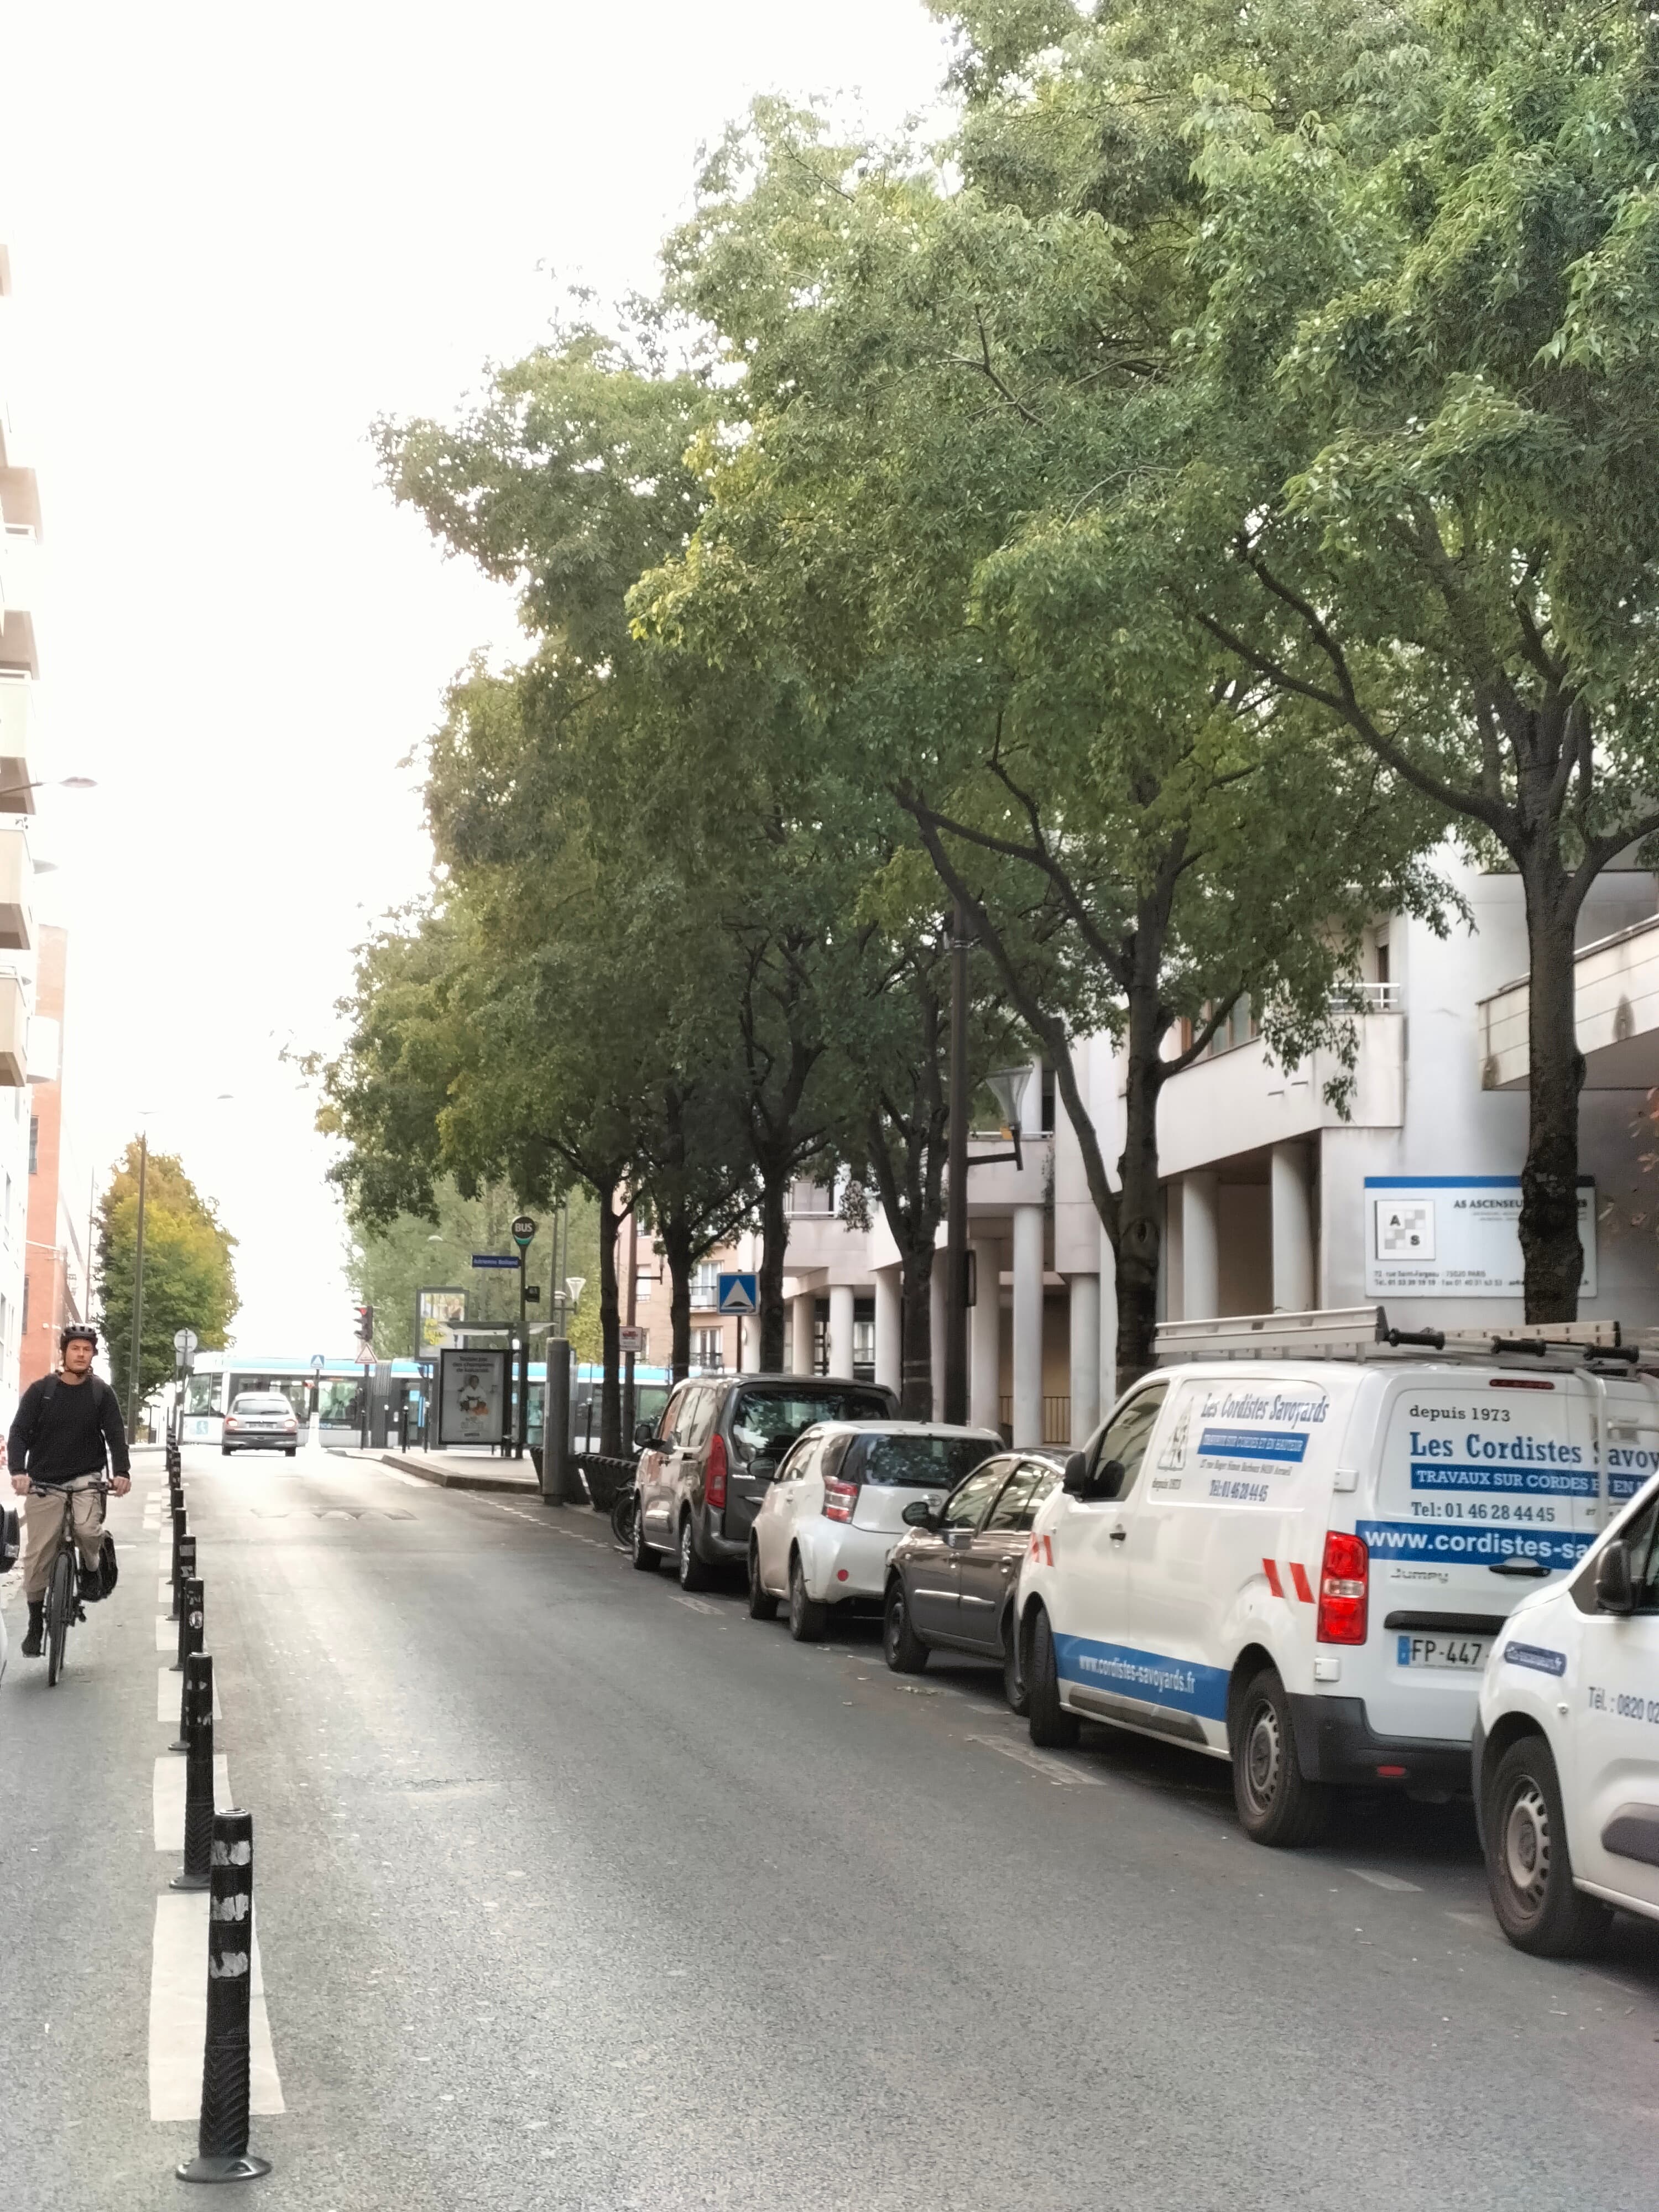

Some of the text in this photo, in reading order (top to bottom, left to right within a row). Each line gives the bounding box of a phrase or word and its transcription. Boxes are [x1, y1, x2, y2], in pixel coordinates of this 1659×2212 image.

[1453, 1199, 1524, 1208] AS ASCENSEU
[514, 1223, 533, 1232] BUS
[1390, 1215, 1401, 1226] A
[1410, 1235, 1420, 1246] S
[1200, 1392, 1330, 1430] Les Cordistes Savoyards
[1410, 1405, 1511, 1422] depuis 1973
[1410, 1431, 1453, 1457] Les
[1467, 1433, 1582, 1464] Cordistes
[1417, 1470, 1491, 1485] TRAVAUX
[1493, 1473, 1524, 1487] SUR
[1526, 1474, 1589, 1490] CORDES
[1613, 1479, 1635, 1493] EN
[1411, 1501, 1442, 1517] Tel:
[1445, 1503, 1464, 1518] 01
[1468, 1503, 1488, 1519] 46
[1491, 1504, 1510, 1520] 28
[1365, 1531, 1587, 1559] www.cordistes-sa
[1079, 1655, 1196, 1694] www.cordistes-savoyards.fr
